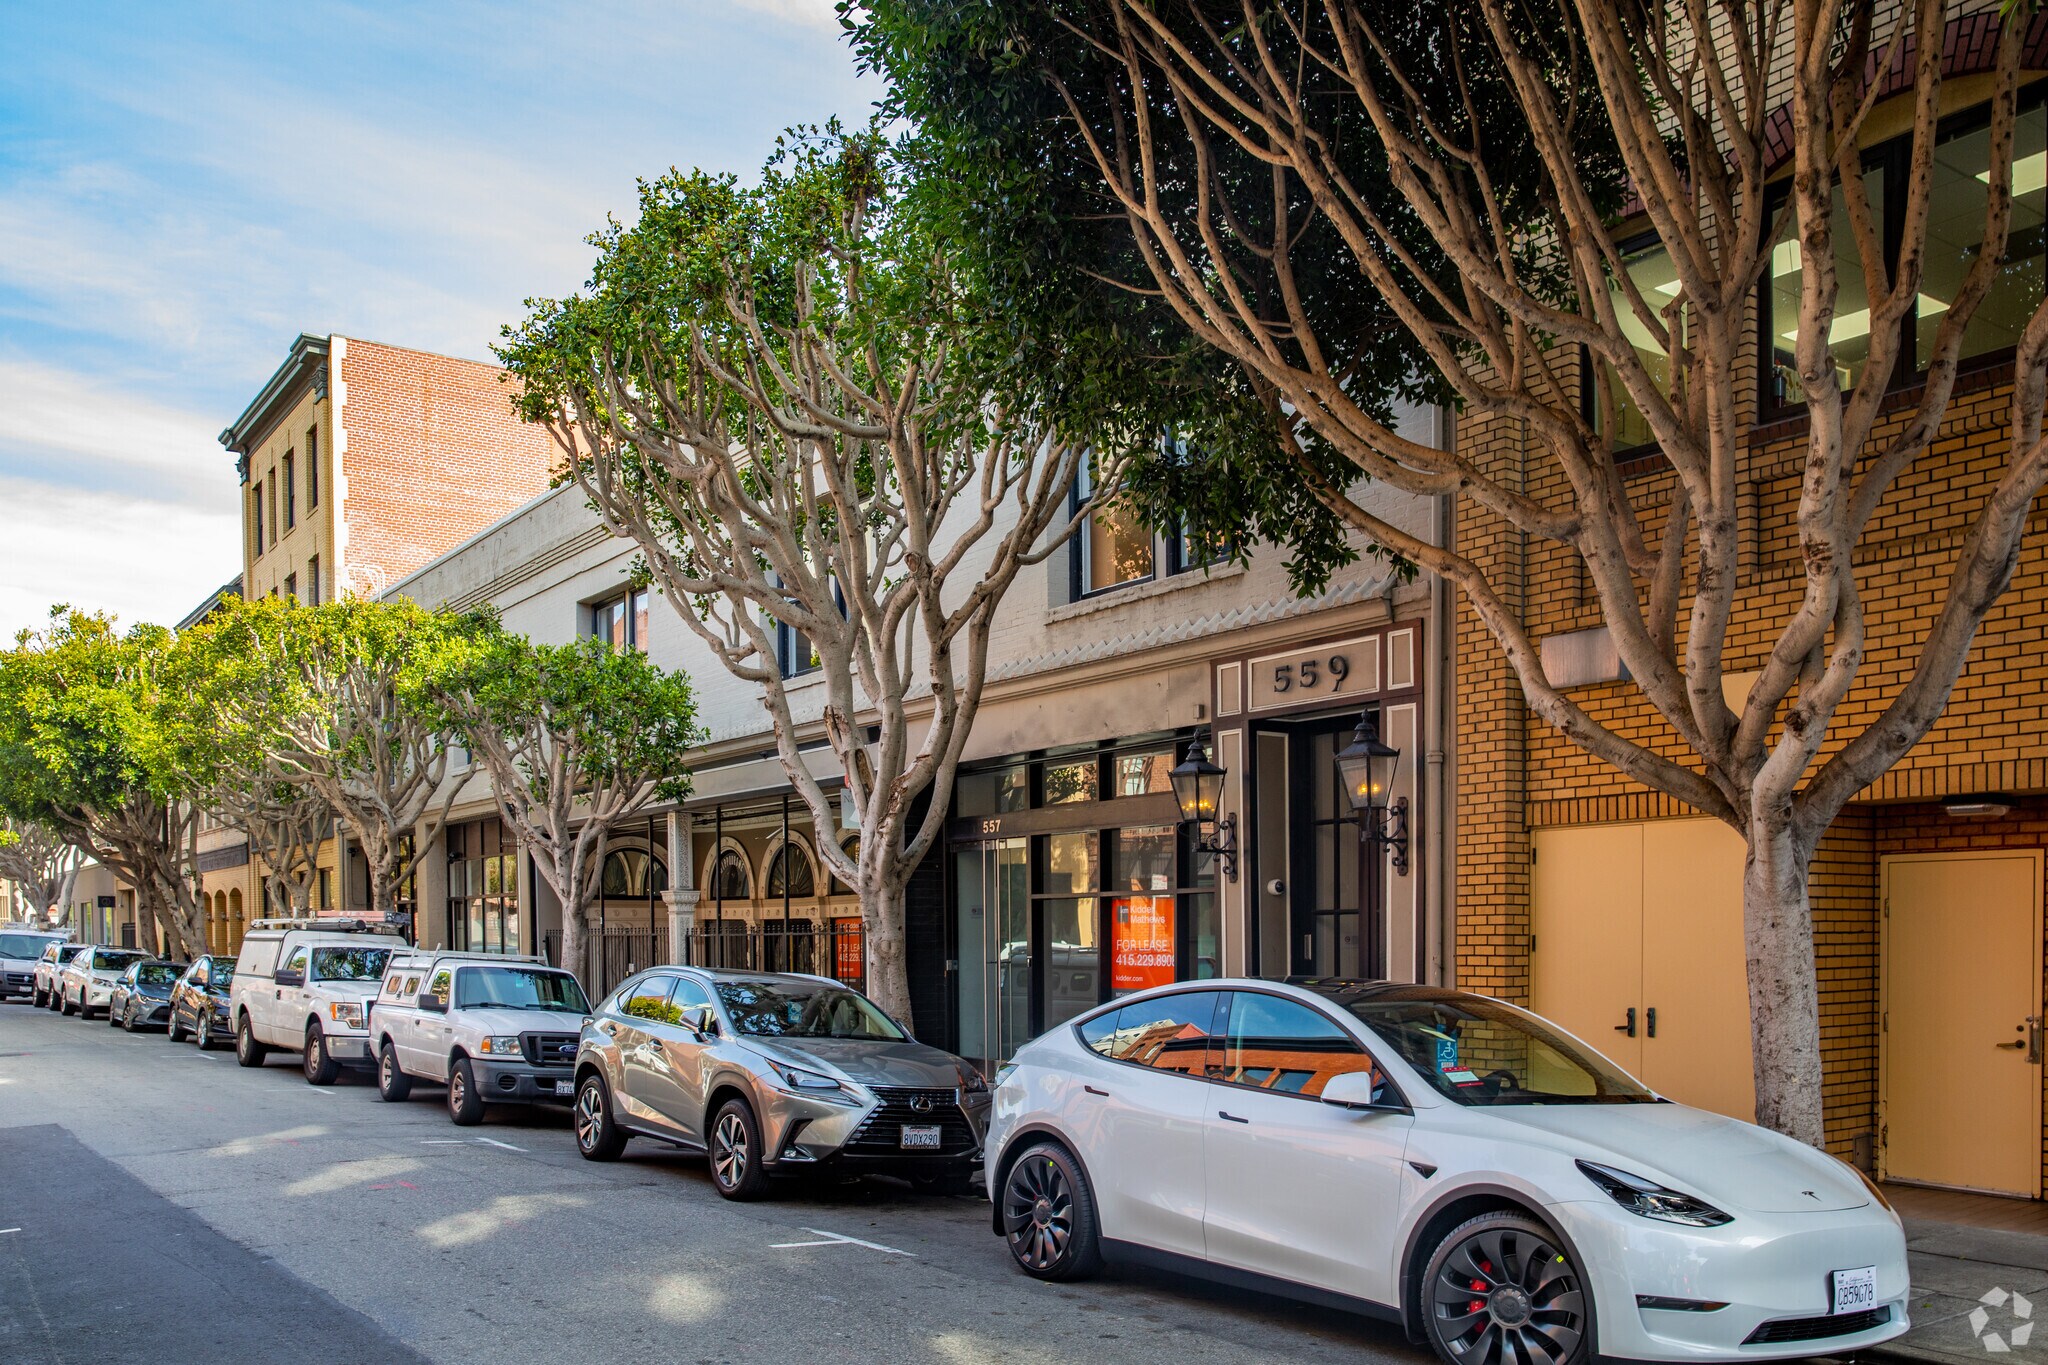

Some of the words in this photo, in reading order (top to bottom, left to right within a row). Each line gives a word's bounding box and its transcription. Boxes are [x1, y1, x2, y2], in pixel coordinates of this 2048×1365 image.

[1274, 655, 1349, 693] 559
[982, 819, 1001, 834] 557
[1116, 939, 1137, 951] FOR
[1138, 939, 1168, 952] LEASE
[1115, 974, 1144, 982] kidder.com
[903, 1133, 939, 1146] 8VDX290
[1837, 1283, 1874, 1306] CB59G78
